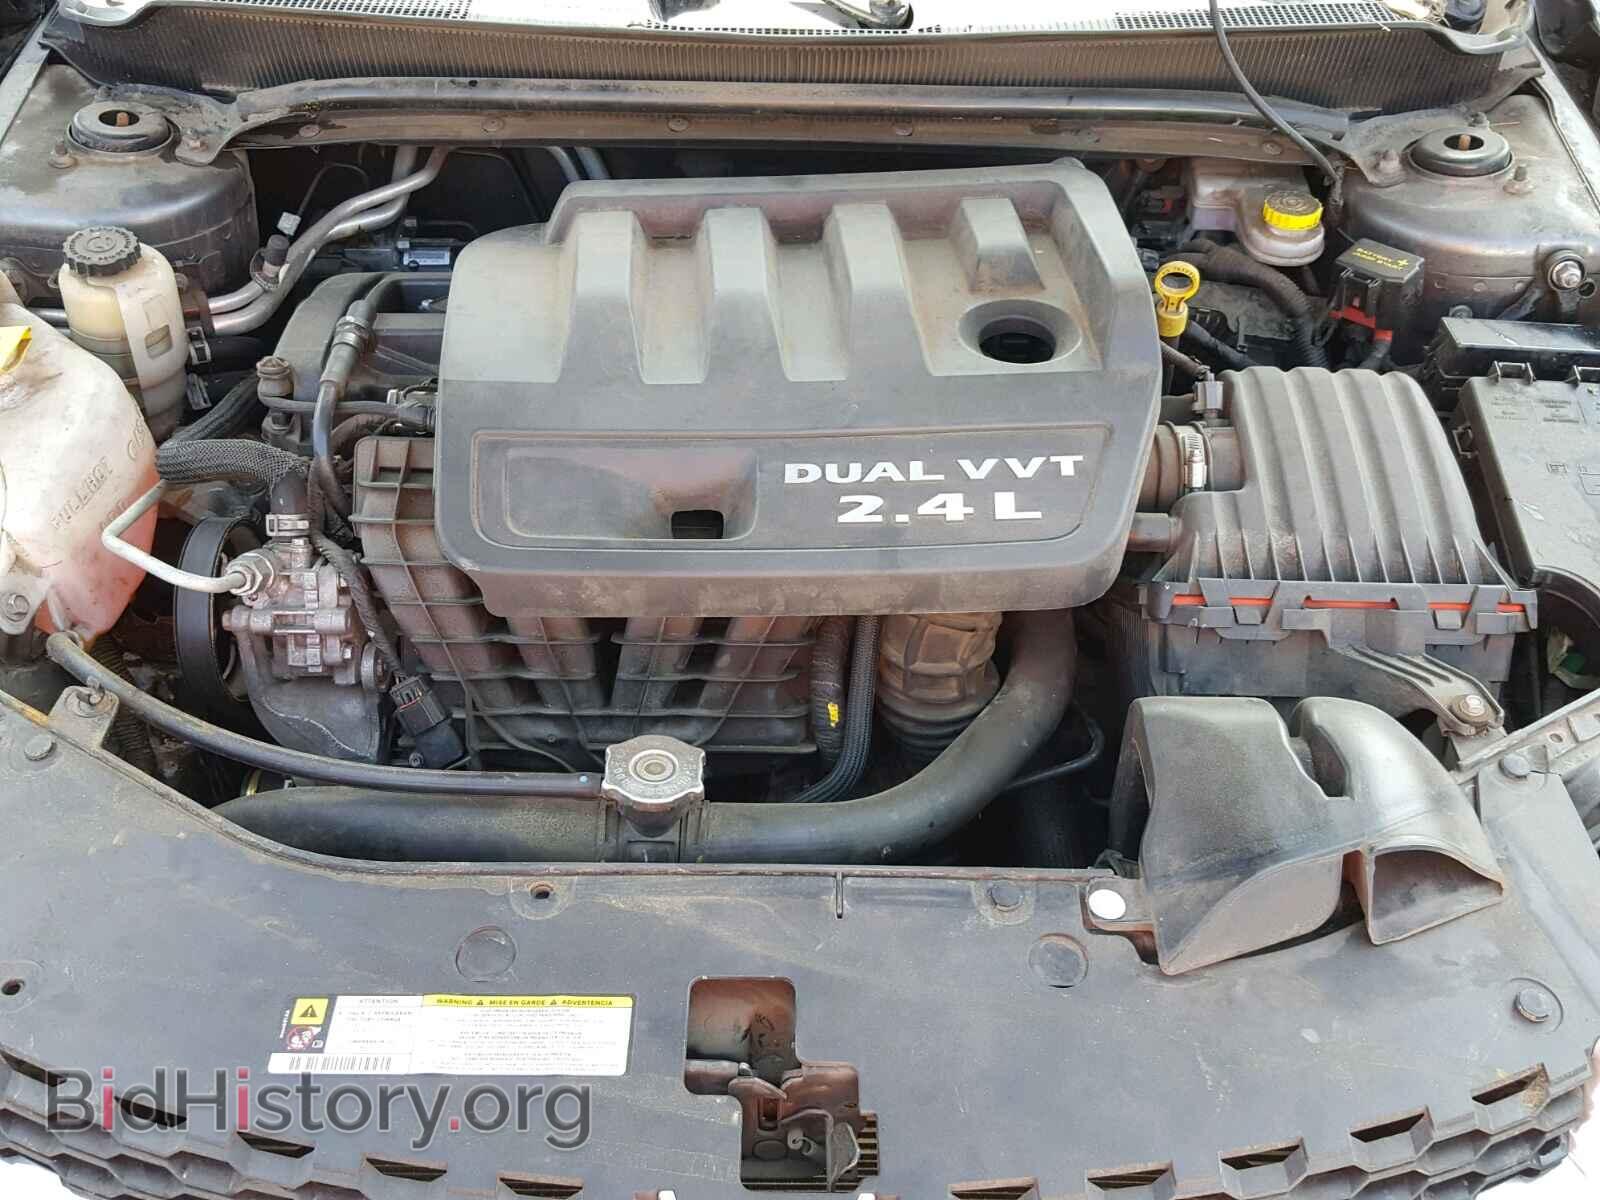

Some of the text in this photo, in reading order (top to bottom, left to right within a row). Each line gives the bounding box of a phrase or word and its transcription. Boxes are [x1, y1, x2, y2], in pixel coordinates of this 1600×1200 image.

[784, 455, 1084, 483] DUAL VVT
[436, 998, 473, 1006] WARNING
[489, 999, 508, 1007] MISE
[509, 999, 519, 1007] EN
[520, 999, 546, 1007] GARDE
